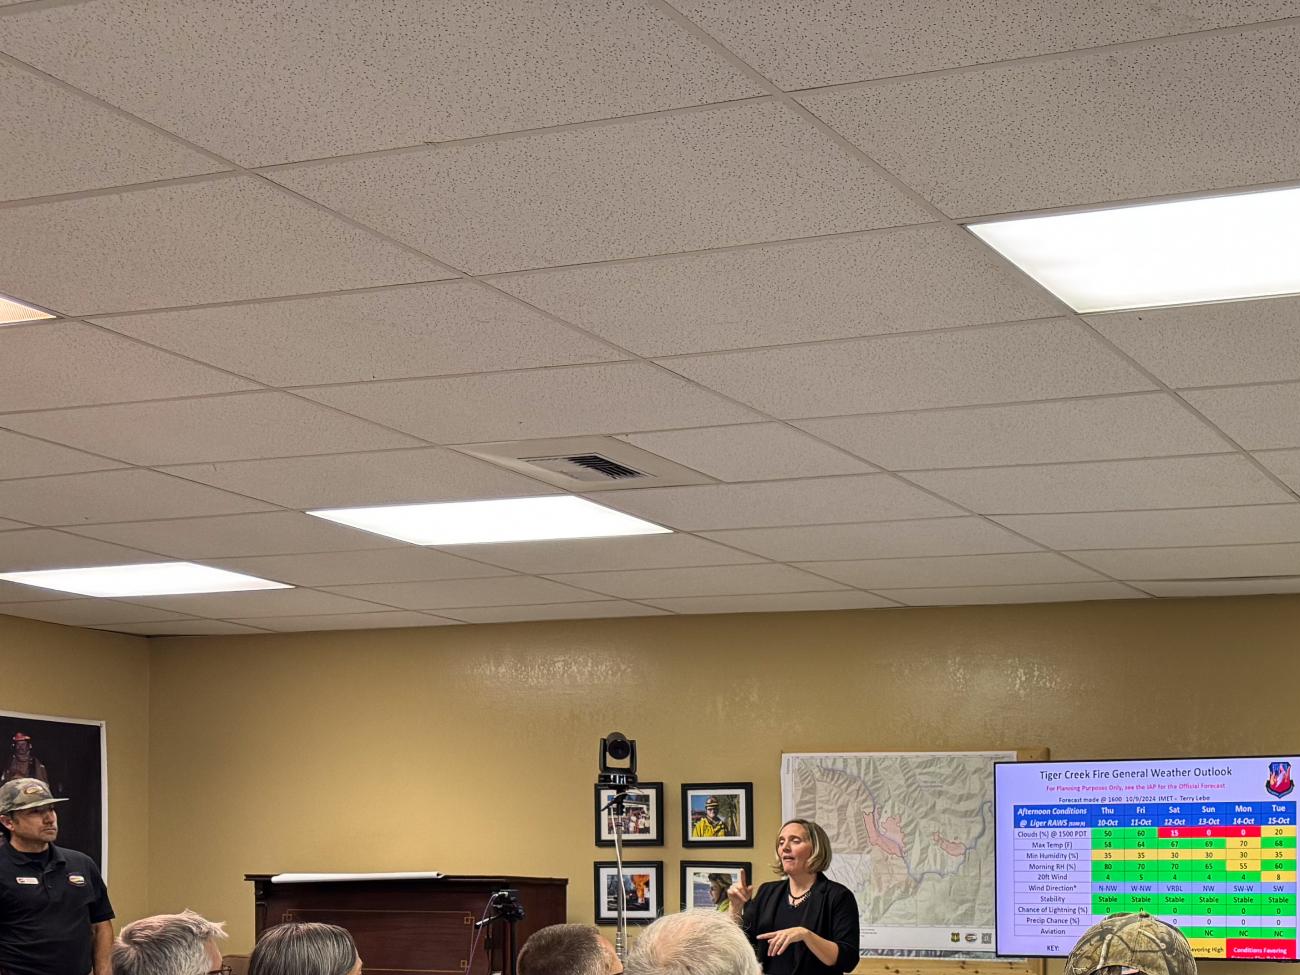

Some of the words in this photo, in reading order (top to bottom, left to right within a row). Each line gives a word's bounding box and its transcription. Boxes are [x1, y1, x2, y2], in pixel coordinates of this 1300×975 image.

[1040, 770, 1061, 781] Tiger
[1065, 770, 1090, 779] Creek
[1093, 770, 1110, 779] Fire
[1112, 769, 1148, 779] General
[1151, 768, 1191, 778] Weather
[1194, 766, 1232, 777] Outlook
[1017, 808, 1051, 816] Afternoon
[1052, 807, 1087, 815] Conditions
[1101, 806, 1115, 814] Thu
[1136, 806, 1146, 814] Fri
[1168, 806, 1181, 814] Sat
[1201, 805, 1216, 813] Sun
[1271, 804, 1286, 812] Tue
[1020, 819, 1028, 827] @
[1164, 818, 1186, 826] 12-Oct
[1268, 817, 1291, 825] 15-Oct
[1039, 831, 1049, 839] (%)
[1050, 831, 1058, 839] @
[1170, 829, 1179, 837] 15
[1240, 828, 1246, 836] 0
[1064, 841, 1073, 849] (F)
[1029, 863, 1055, 871] Morning
[1066, 863, 1077, 871] (%)
[1274, 862, 1283, 870] 60
[1273, 884, 1285, 892] SW
[1040, 895, 1066, 903] Stability
[1048, 906, 1077, 914] Lightning
[1078, 906, 1088, 915] (%)
[1241, 907, 1246, 915] 0
[1026, 917, 1046, 925] Precip
[1069, 917, 1080, 925] (%)
[1263, 947, 1288, 955] Favoring
